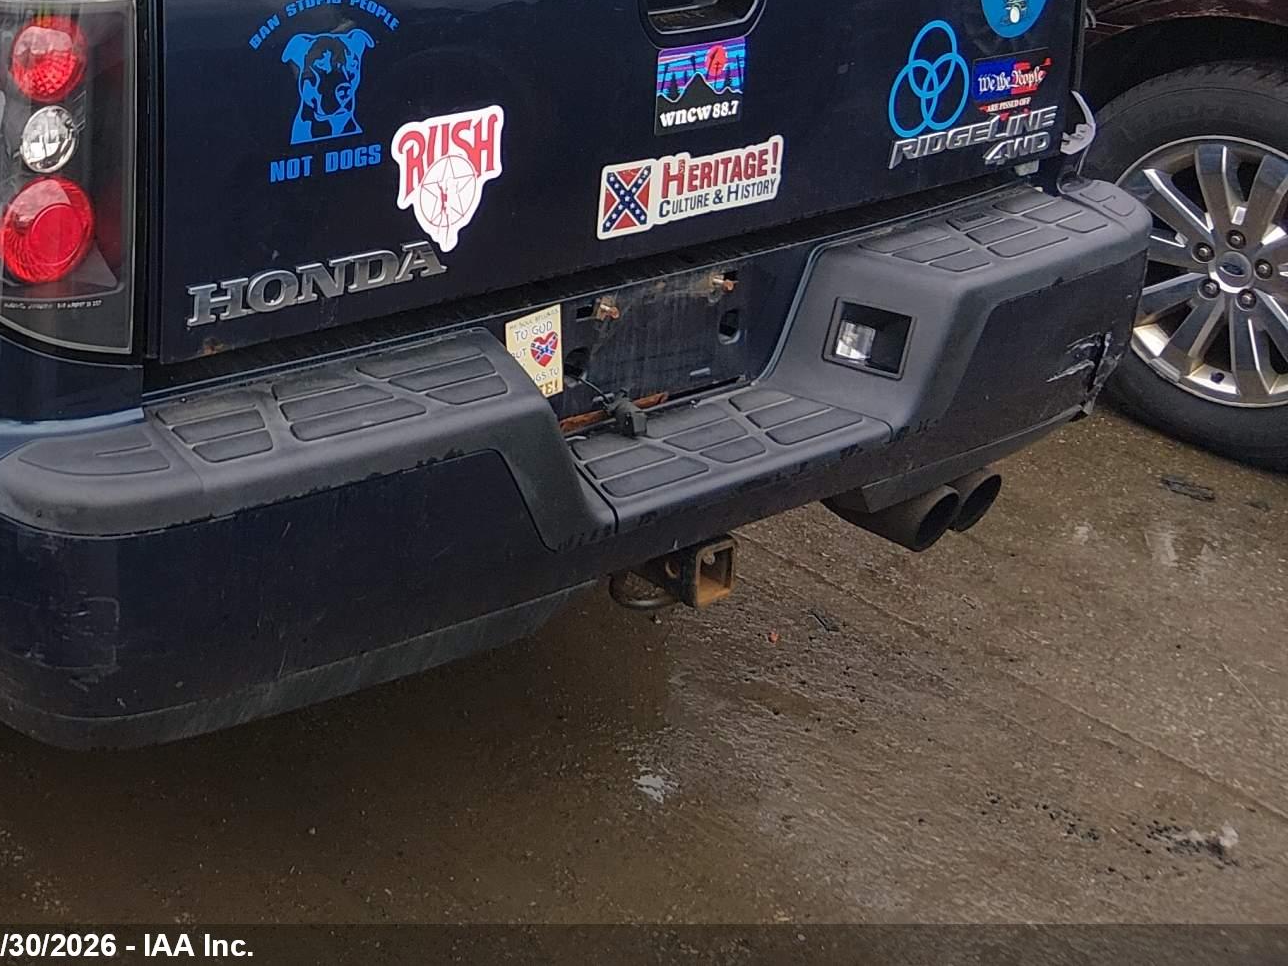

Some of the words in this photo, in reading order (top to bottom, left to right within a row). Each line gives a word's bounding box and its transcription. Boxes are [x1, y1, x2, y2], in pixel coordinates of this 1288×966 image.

[248, 14, 281, 50] BAN
[1011, 65, 1047, 88] People
[712, 100, 740, 119] 88.7
[986, 103, 1000, 113] ARE
[999, 99, 1019, 110] PISSED
[1019, 96, 1032, 106] OFF
[888, 105, 1059, 170] RIDGELINE
[983, 130, 1051, 165] 4WD
[269, 155, 313, 182] NOT
[324, 144, 382, 173] DOGS
[397, 113, 499, 201] RUSH
[659, 192, 710, 218] CULTURE
[712, 188, 724, 205] &
[727, 177, 777, 202] HISTORY
[186, 240, 448, 327] HONDA
[514, 329, 528, 342] TO
[531, 320, 553, 335] GOD
[549, 367, 560, 377] TO
